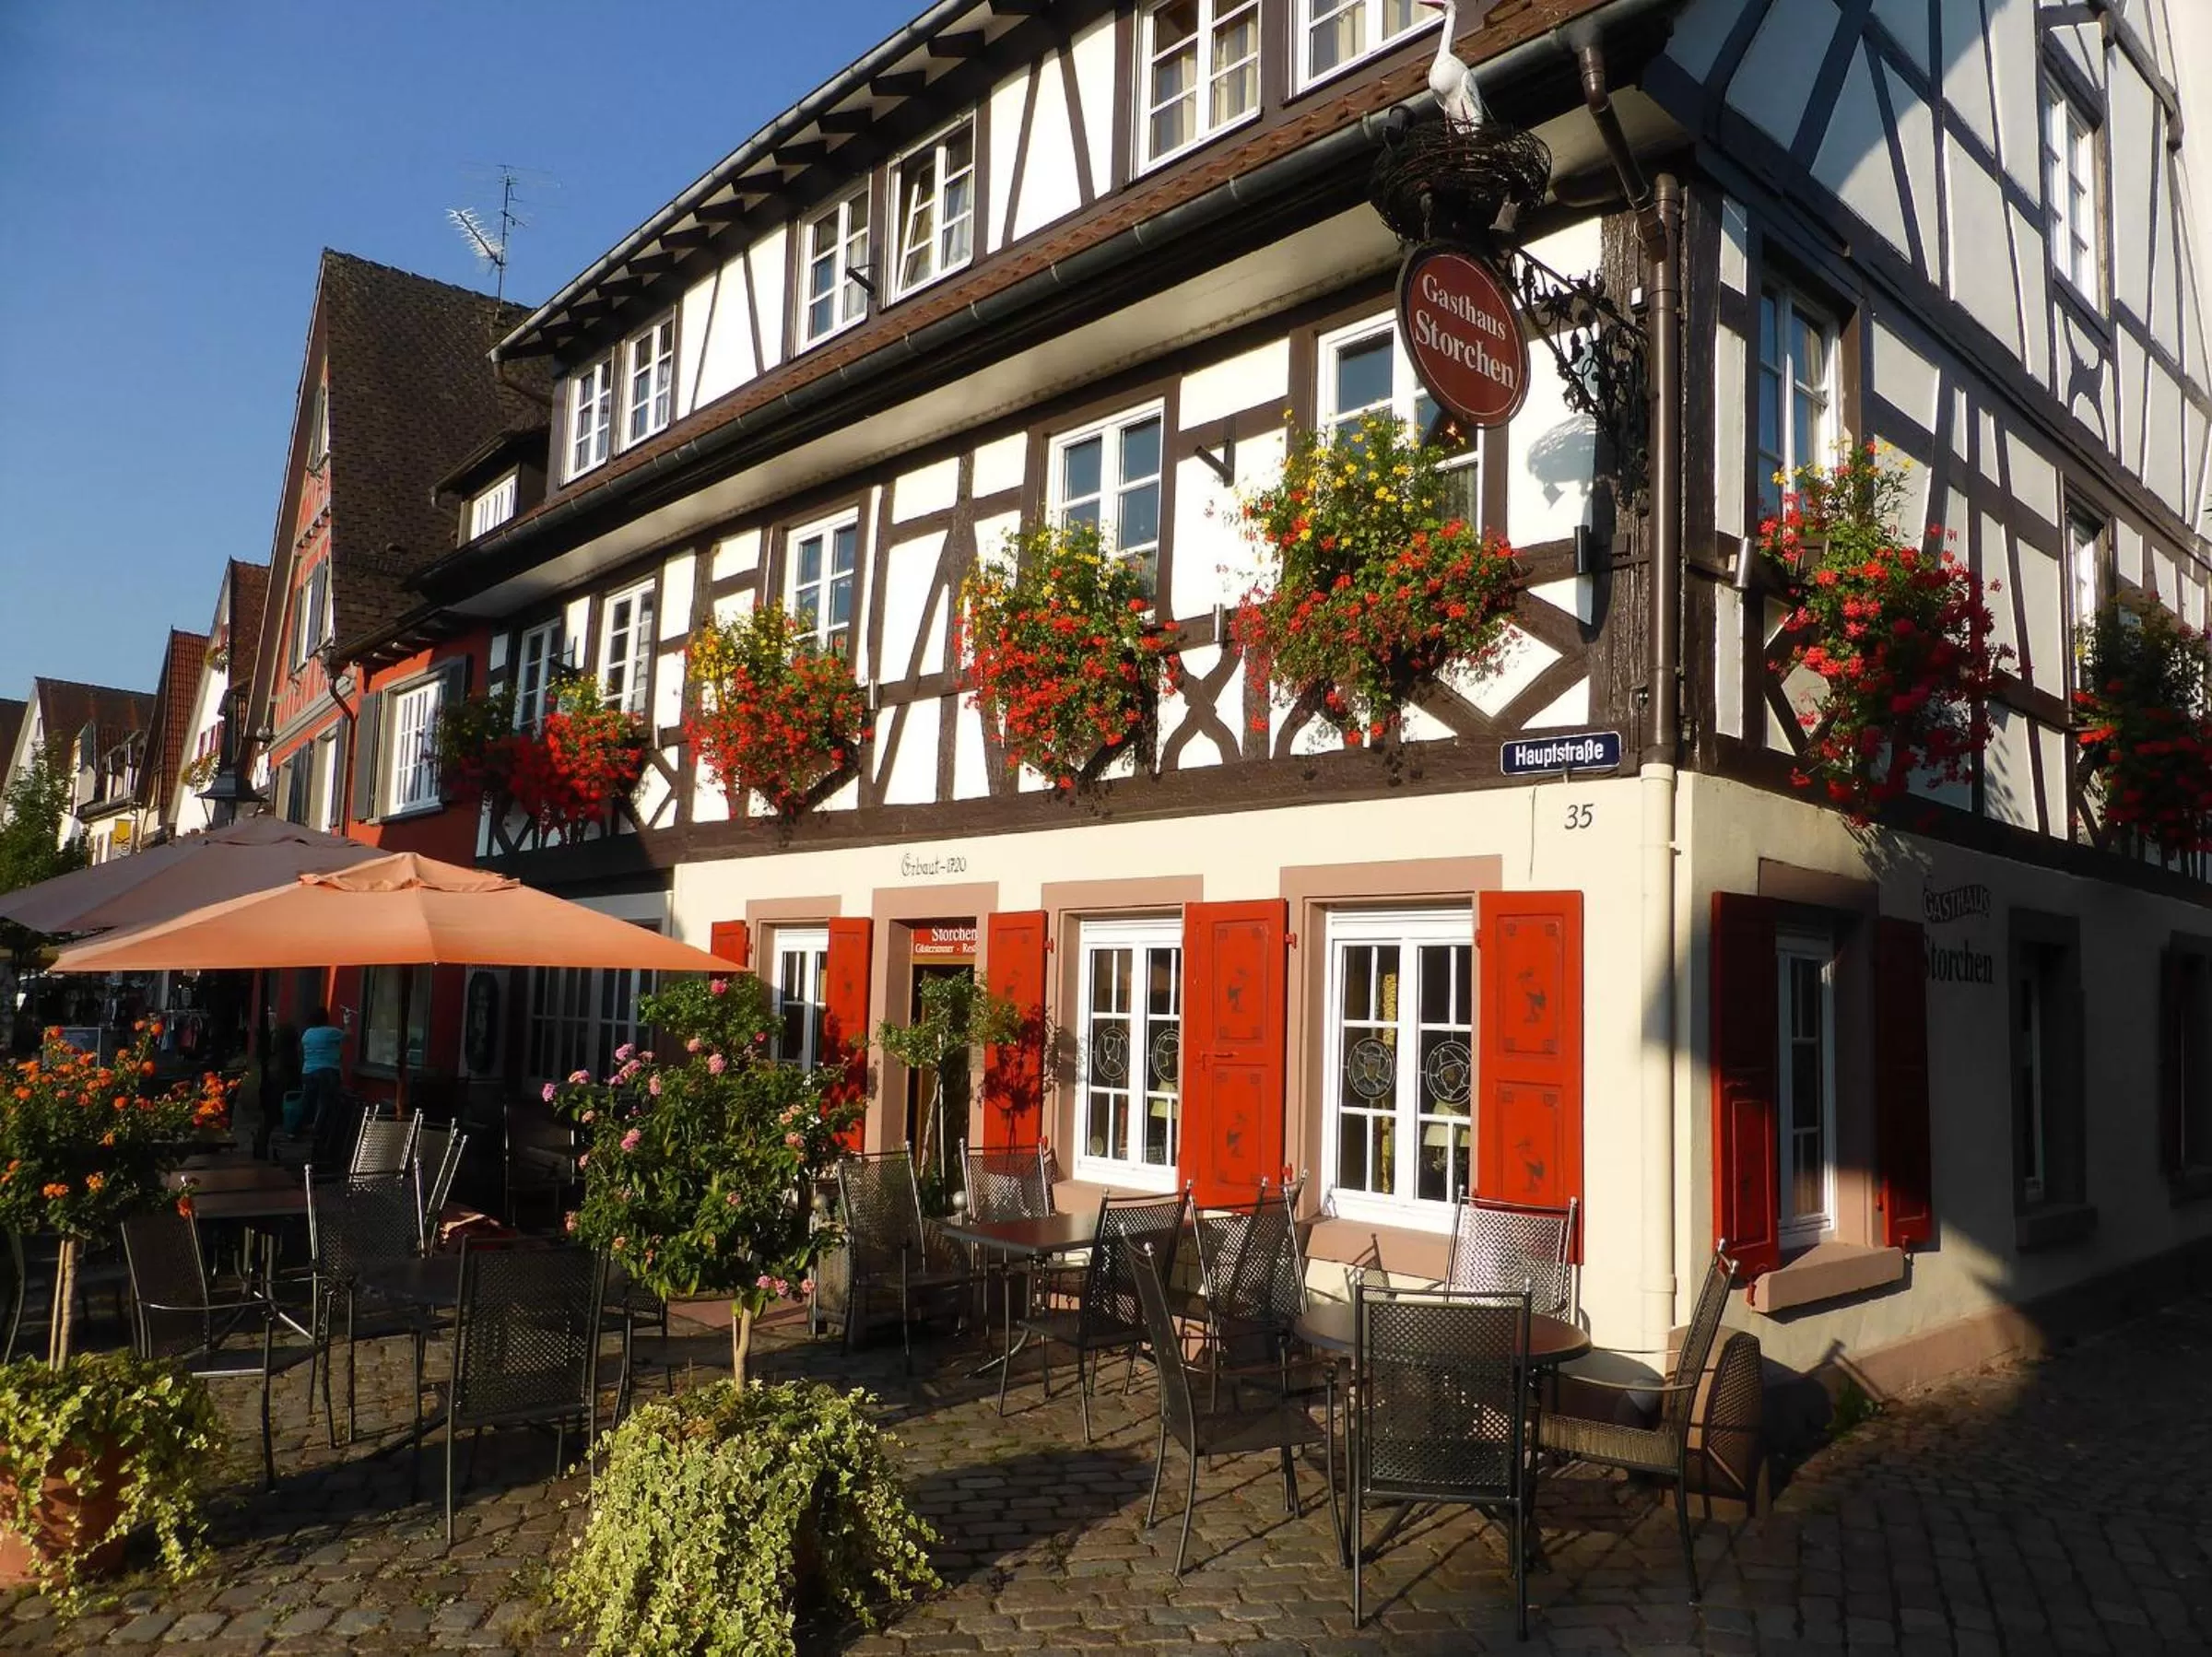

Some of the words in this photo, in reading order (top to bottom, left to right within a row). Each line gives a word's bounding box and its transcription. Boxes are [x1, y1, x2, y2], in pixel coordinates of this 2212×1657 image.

[1422, 274, 1506, 341] Gasthaus
[1416, 309, 1514, 390] Storchen
[1514, 739, 1604, 768] Hauptstraße
[1564, 803, 1594, 830] 35
[1924, 886, 1992, 922] GASTHAUS
[932, 927, 978, 942] Storchen
[1924, 935, 1994, 985] torchen
